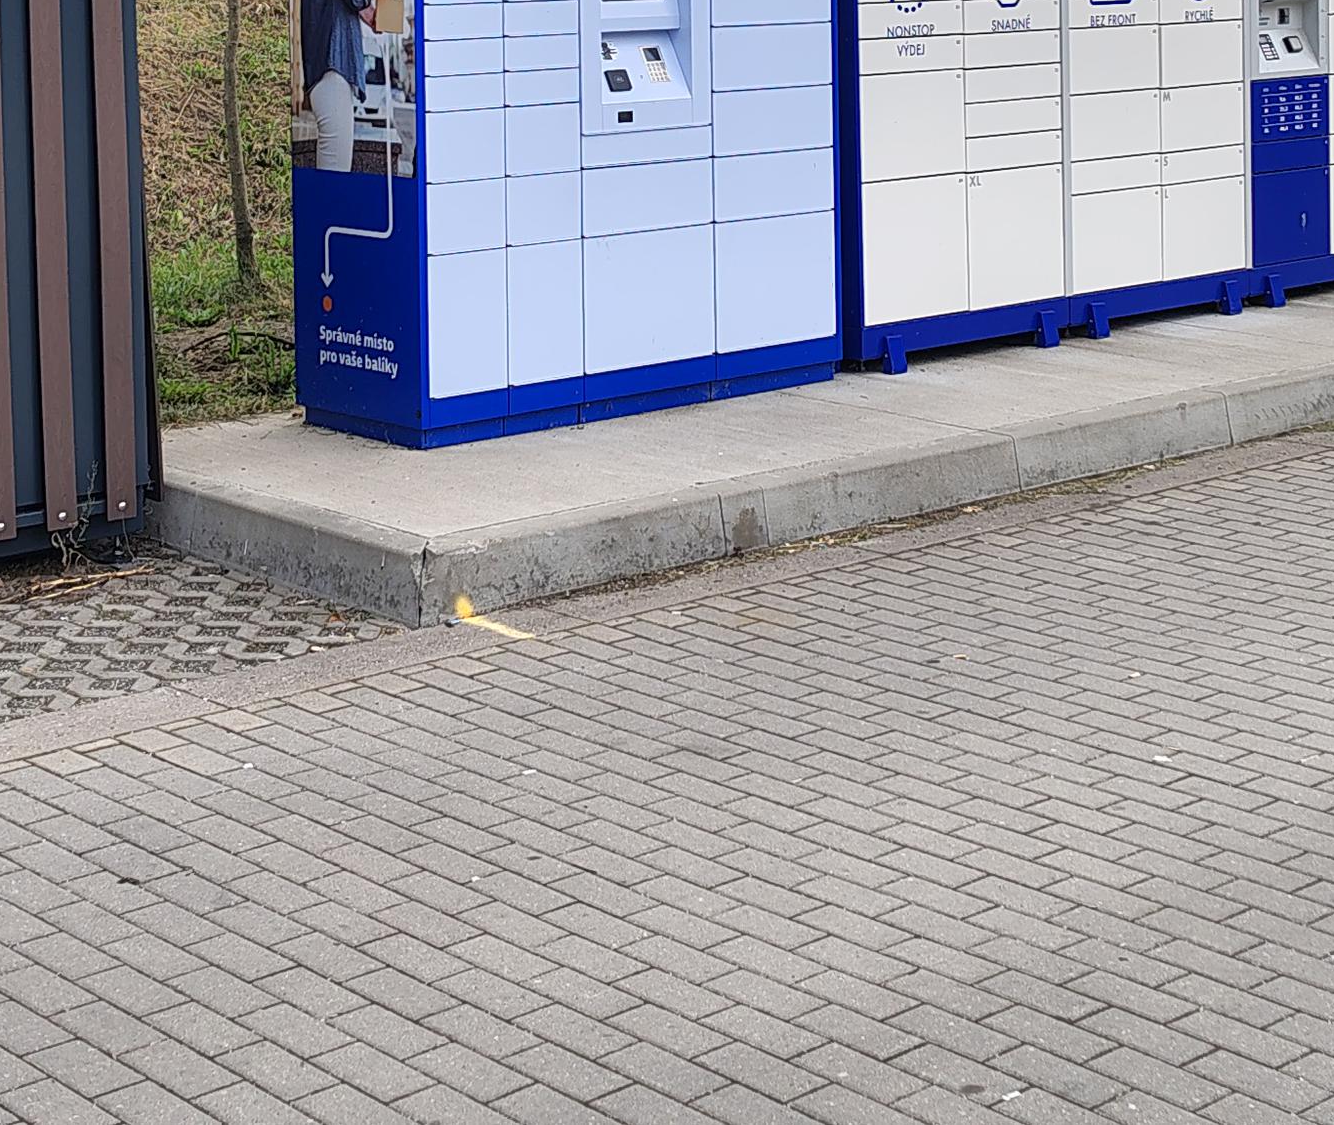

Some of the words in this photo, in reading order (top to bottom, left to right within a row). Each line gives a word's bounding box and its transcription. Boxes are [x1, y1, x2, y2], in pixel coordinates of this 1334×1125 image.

[991, 14, 1031, 32] SNADNÉ
[1090, 15, 1105, 26] BEZ
[1107, 13, 1136, 25] FRONT
[886, 24, 935, 37] NONSTOP
[897, 41, 925, 56] VÝDEJ
[1162, 91, 1171, 102] M
[969, 175, 981, 187] XL
[319, 325, 362, 346] Správné
[363, 333, 394, 352] místo
[320, 349, 337, 365] pro
[339, 350, 363, 368] vaše
[364, 354, 398, 379] balíky
